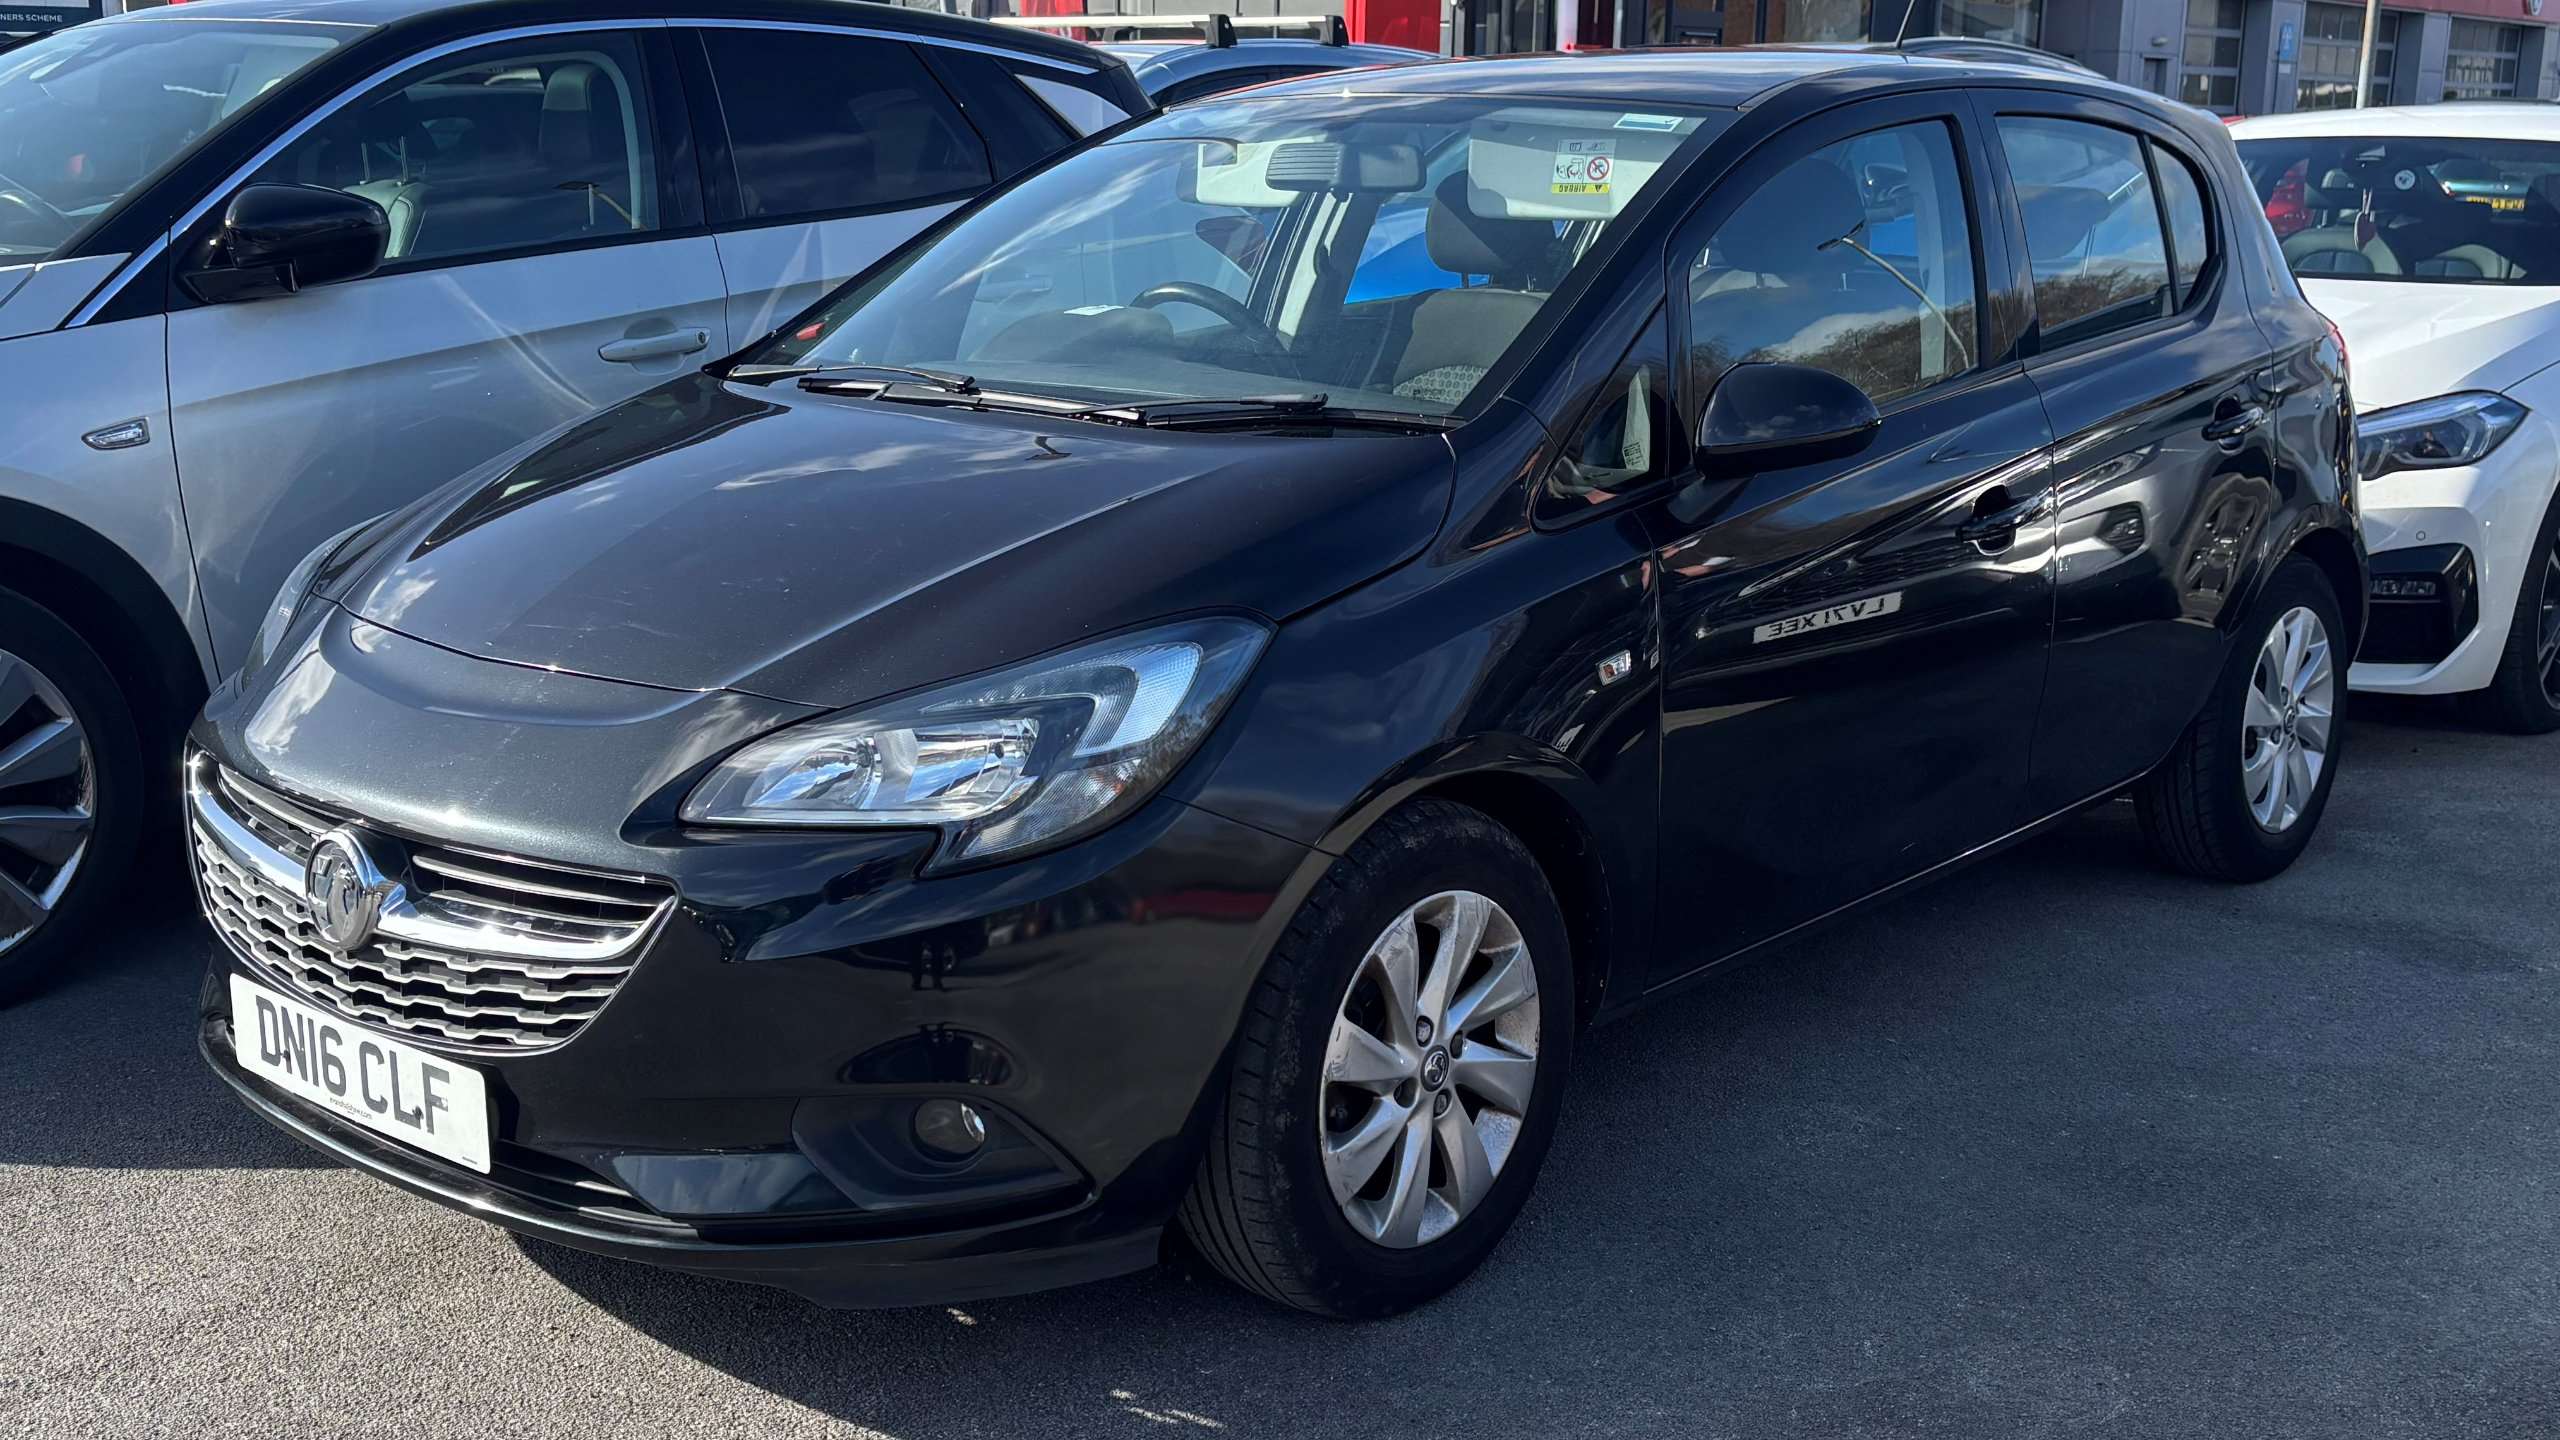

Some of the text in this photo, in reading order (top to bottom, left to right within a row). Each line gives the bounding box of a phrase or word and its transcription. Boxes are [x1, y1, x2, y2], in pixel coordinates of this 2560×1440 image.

[0, 13, 63, 23] NERS SCHEME
[255, 994, 451, 1136] DN16 CLF
